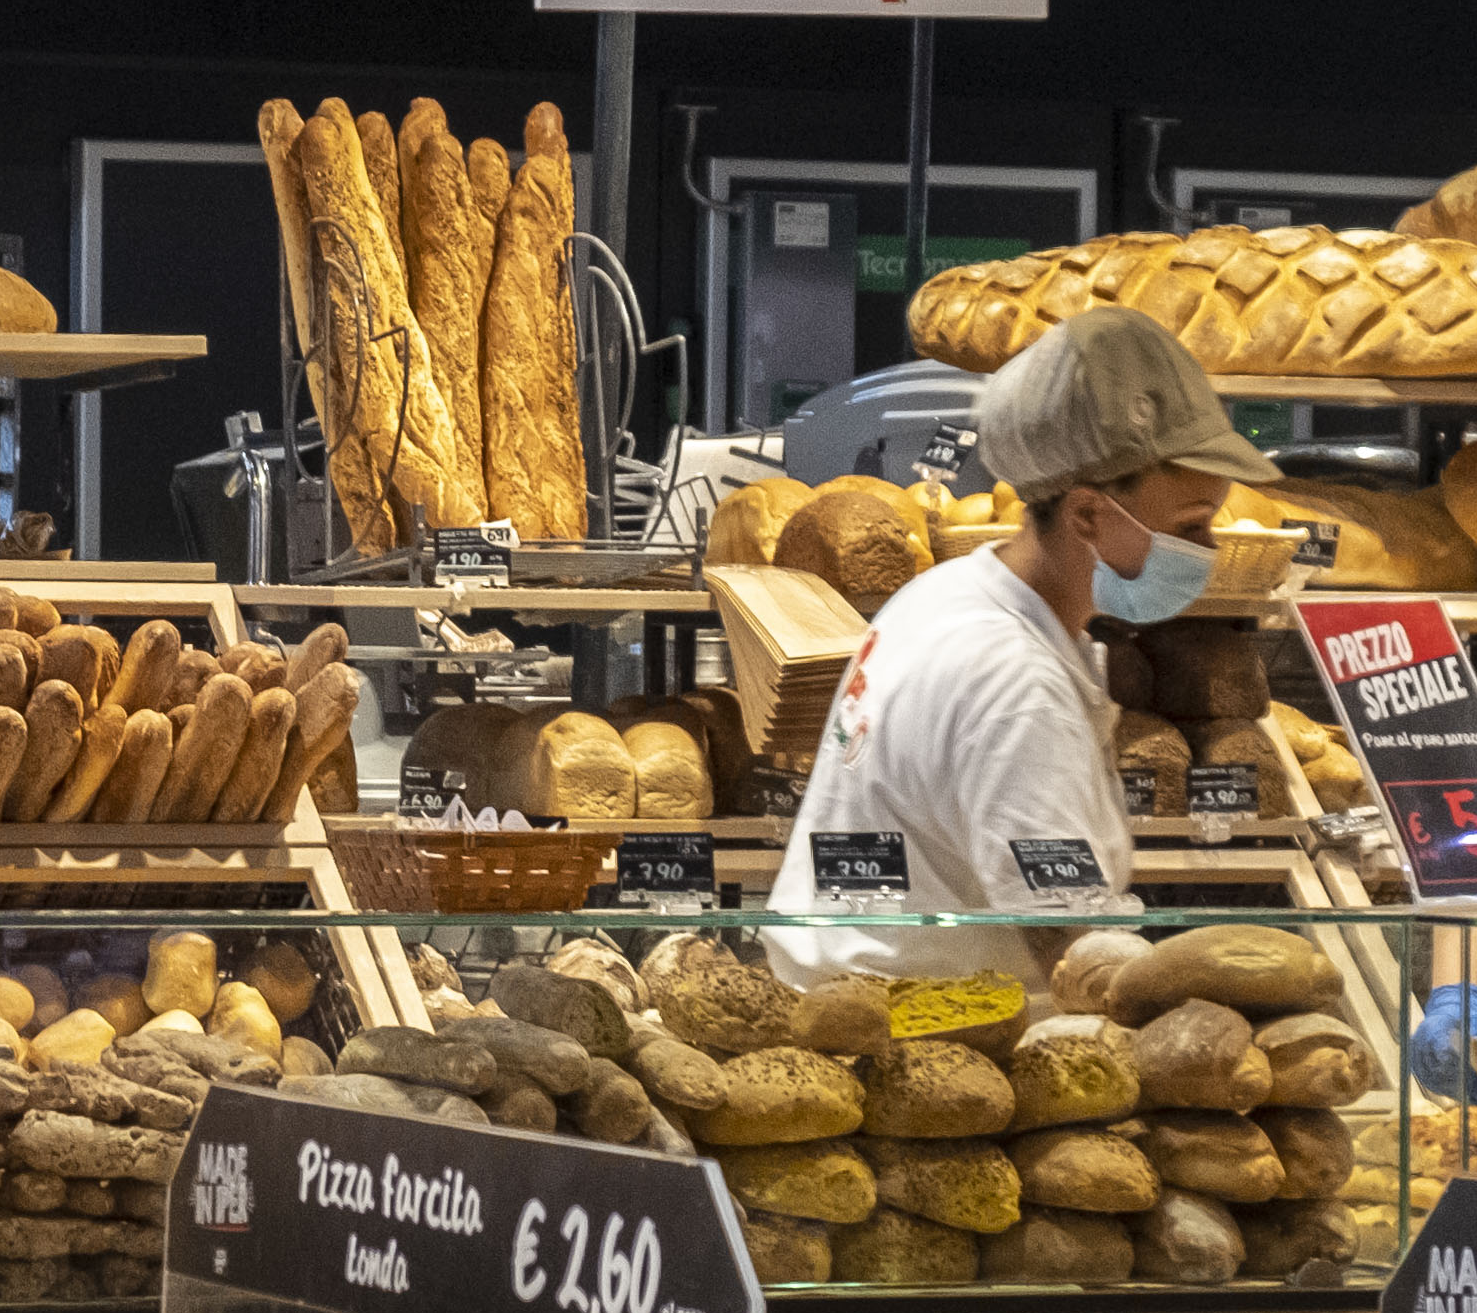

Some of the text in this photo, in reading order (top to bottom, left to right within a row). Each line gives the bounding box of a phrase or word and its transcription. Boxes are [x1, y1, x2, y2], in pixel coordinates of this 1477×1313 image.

[1324, 620, 1414, 679] PREZZO
[1358, 655, 1470, 722] SPECIALE
[1361, 732, 1397, 749] Pane
[1399, 731, 1408, 747] al
[1410, 734, 1445, 754] grano
[197, 1142, 249, 1184] MADE
[296, 1139, 484, 1236] Pizza farcita
[193, 1182, 250, 1225] IN IPER
[345, 1232, 410, 1294] tonda
[512, 1198, 547, 1302] €
